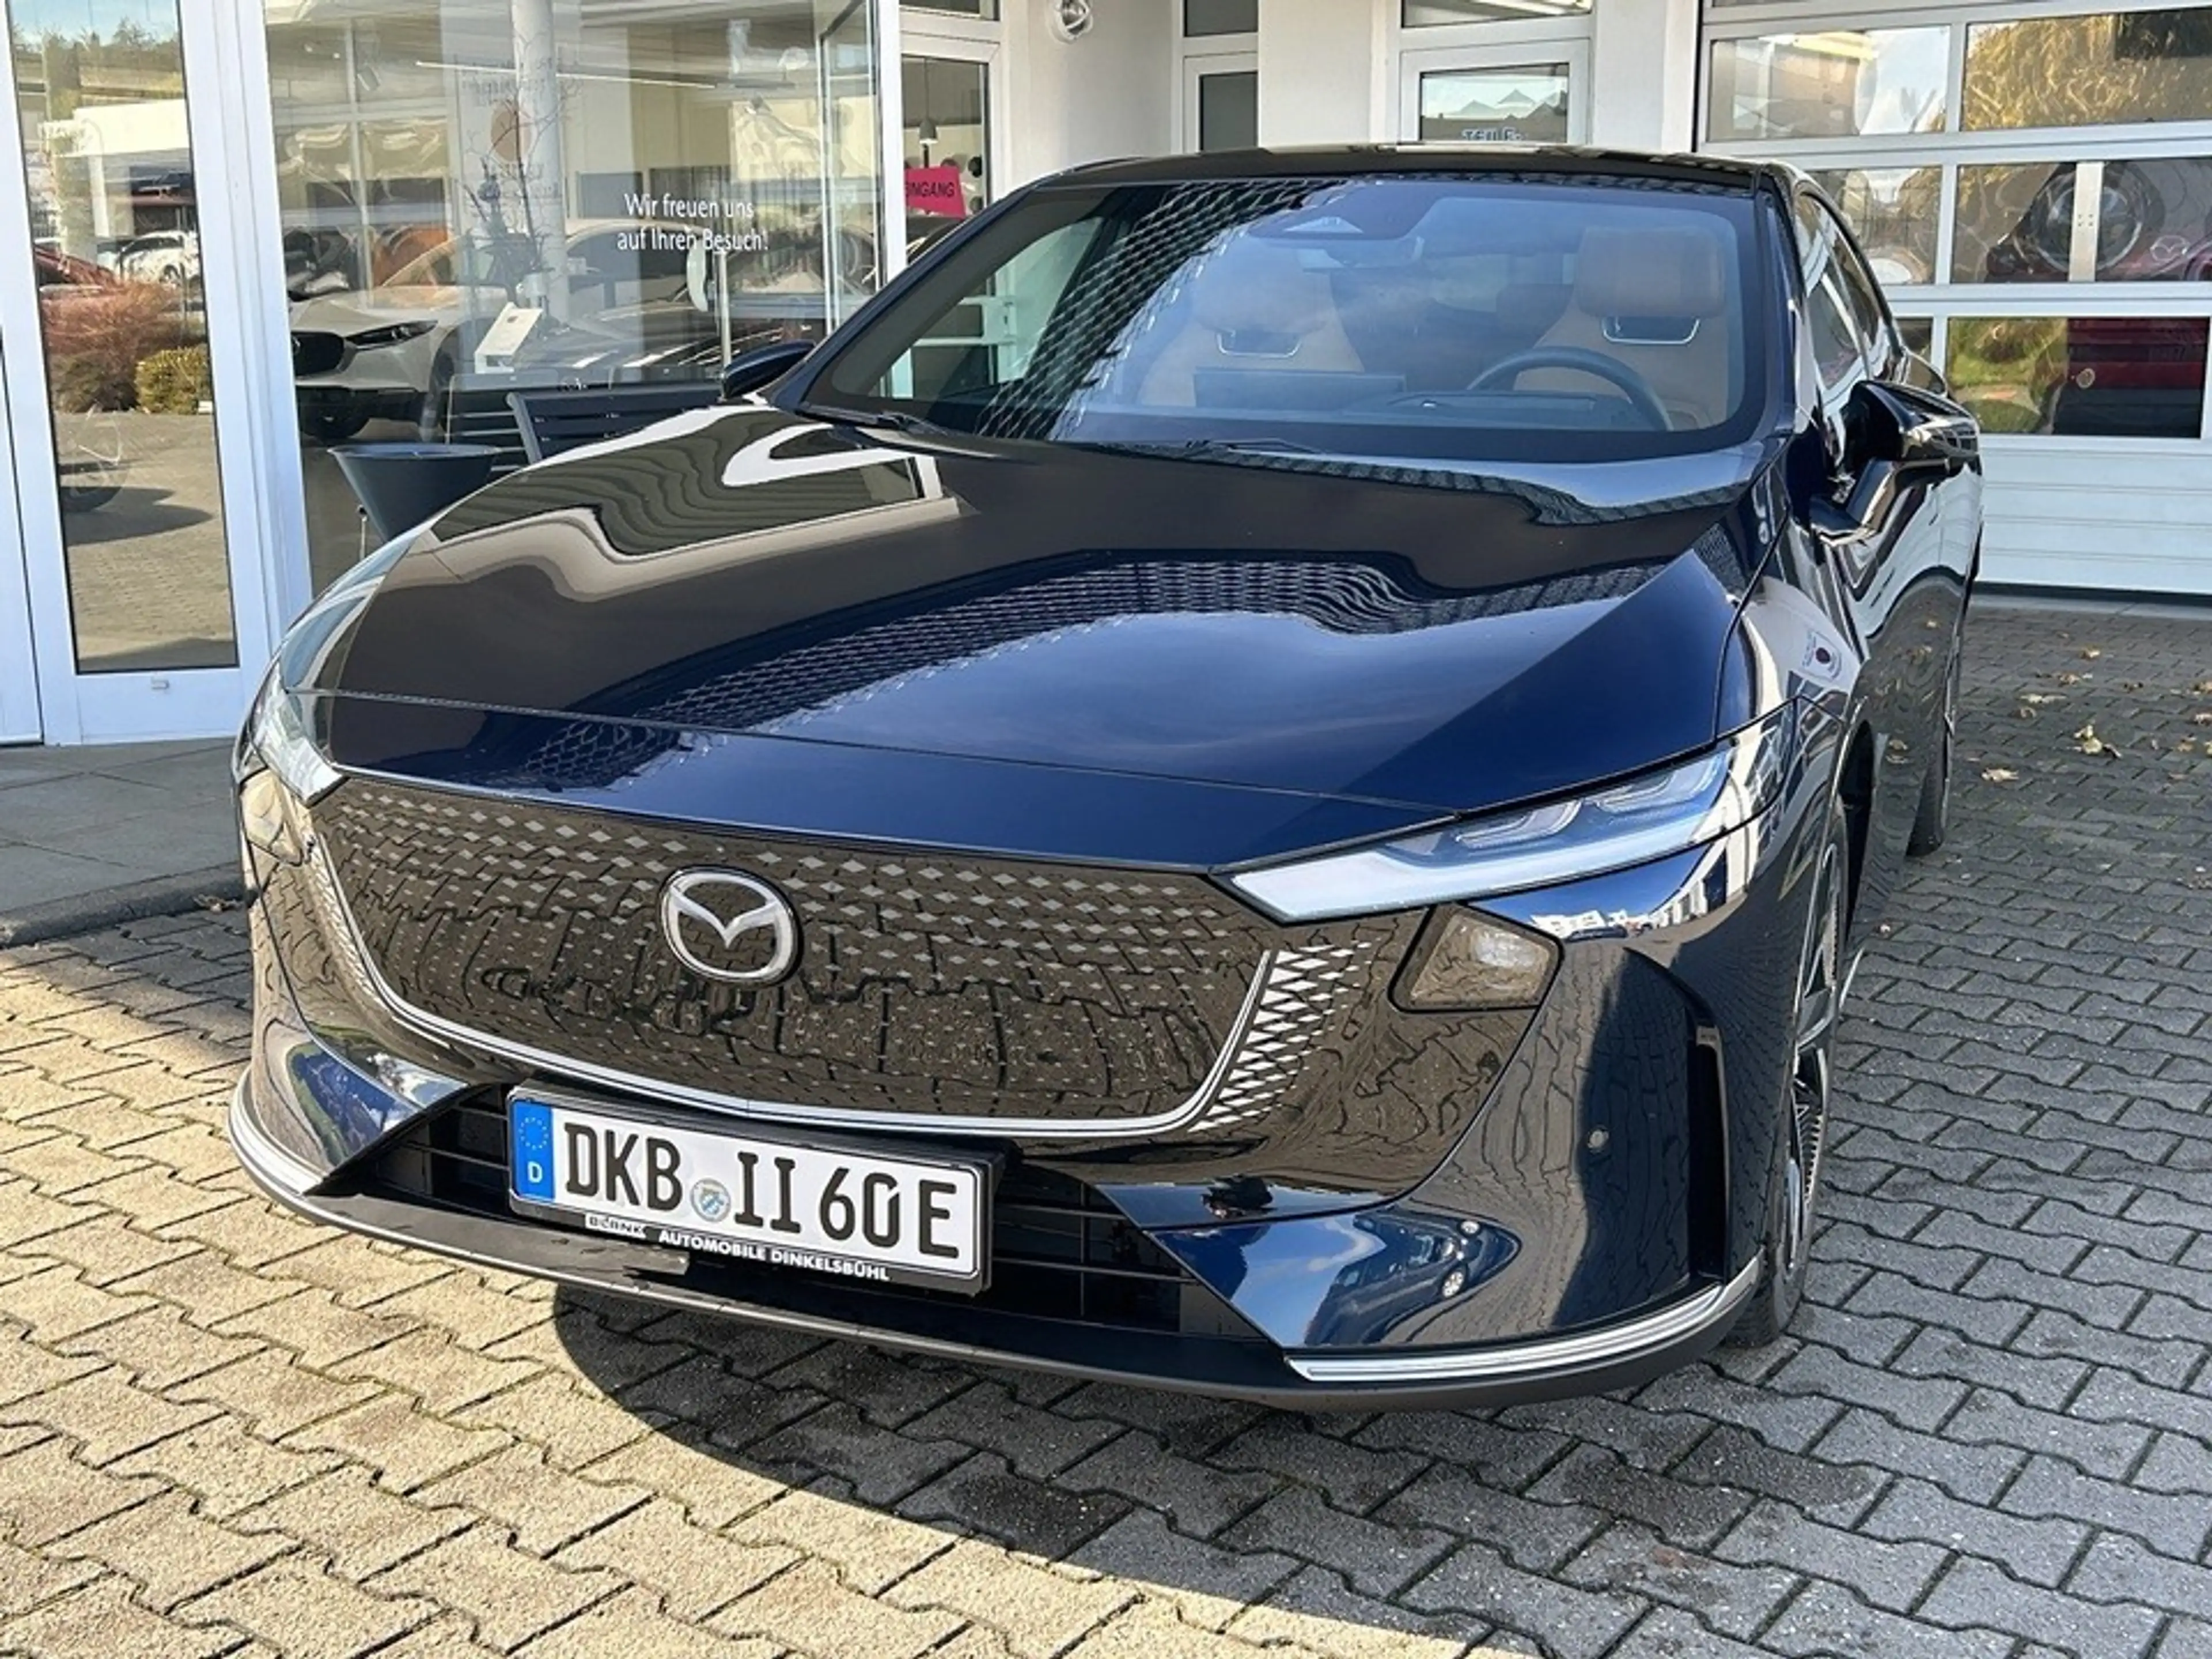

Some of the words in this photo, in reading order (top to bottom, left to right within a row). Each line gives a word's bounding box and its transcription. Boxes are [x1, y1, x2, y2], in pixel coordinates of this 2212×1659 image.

[624, 193, 658, 217] Wir
[663, 192, 719, 218] freuen
[724, 200, 755, 218] uns
[616, 225, 646, 250] auf
[652, 226, 698, 250] Ihren
[702, 227, 769, 251] Besuch!
[527, 1161, 543, 1183] D
[565, 1122, 683, 1211] DKB
[658, 1230, 767, 1261] AUTOMOBILE
[771, 1250, 890, 1281] DINKELSBÜHL
